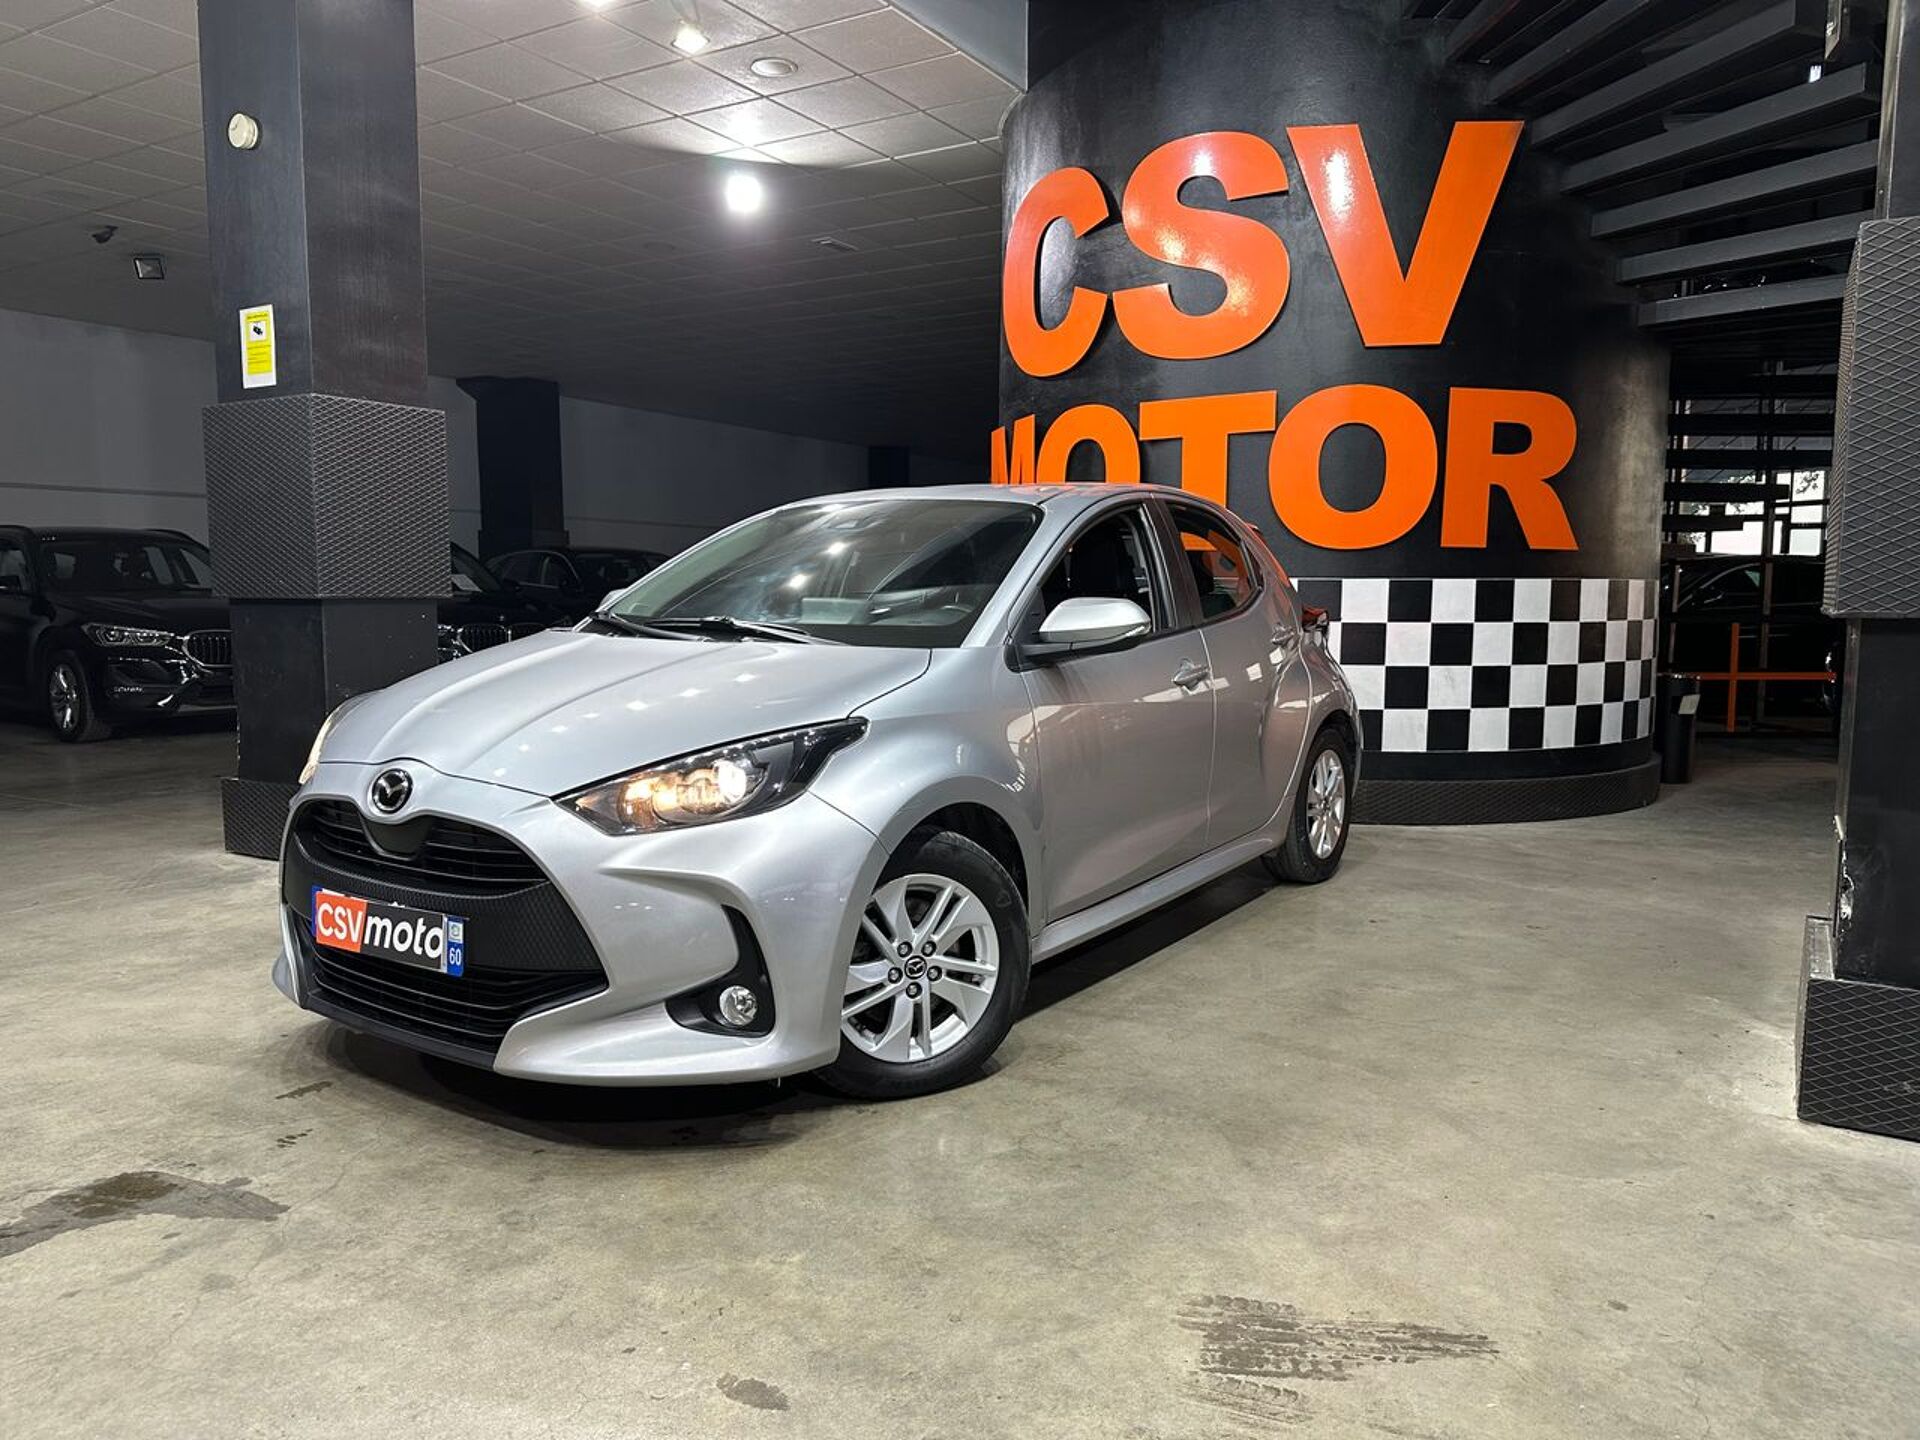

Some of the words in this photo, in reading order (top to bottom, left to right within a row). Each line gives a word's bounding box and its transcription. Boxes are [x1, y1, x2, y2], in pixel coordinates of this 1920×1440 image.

[1003, 120, 1525, 378] CSV
[990, 384, 1579, 551] MOTOR
[449, 947, 462, 966] 60
